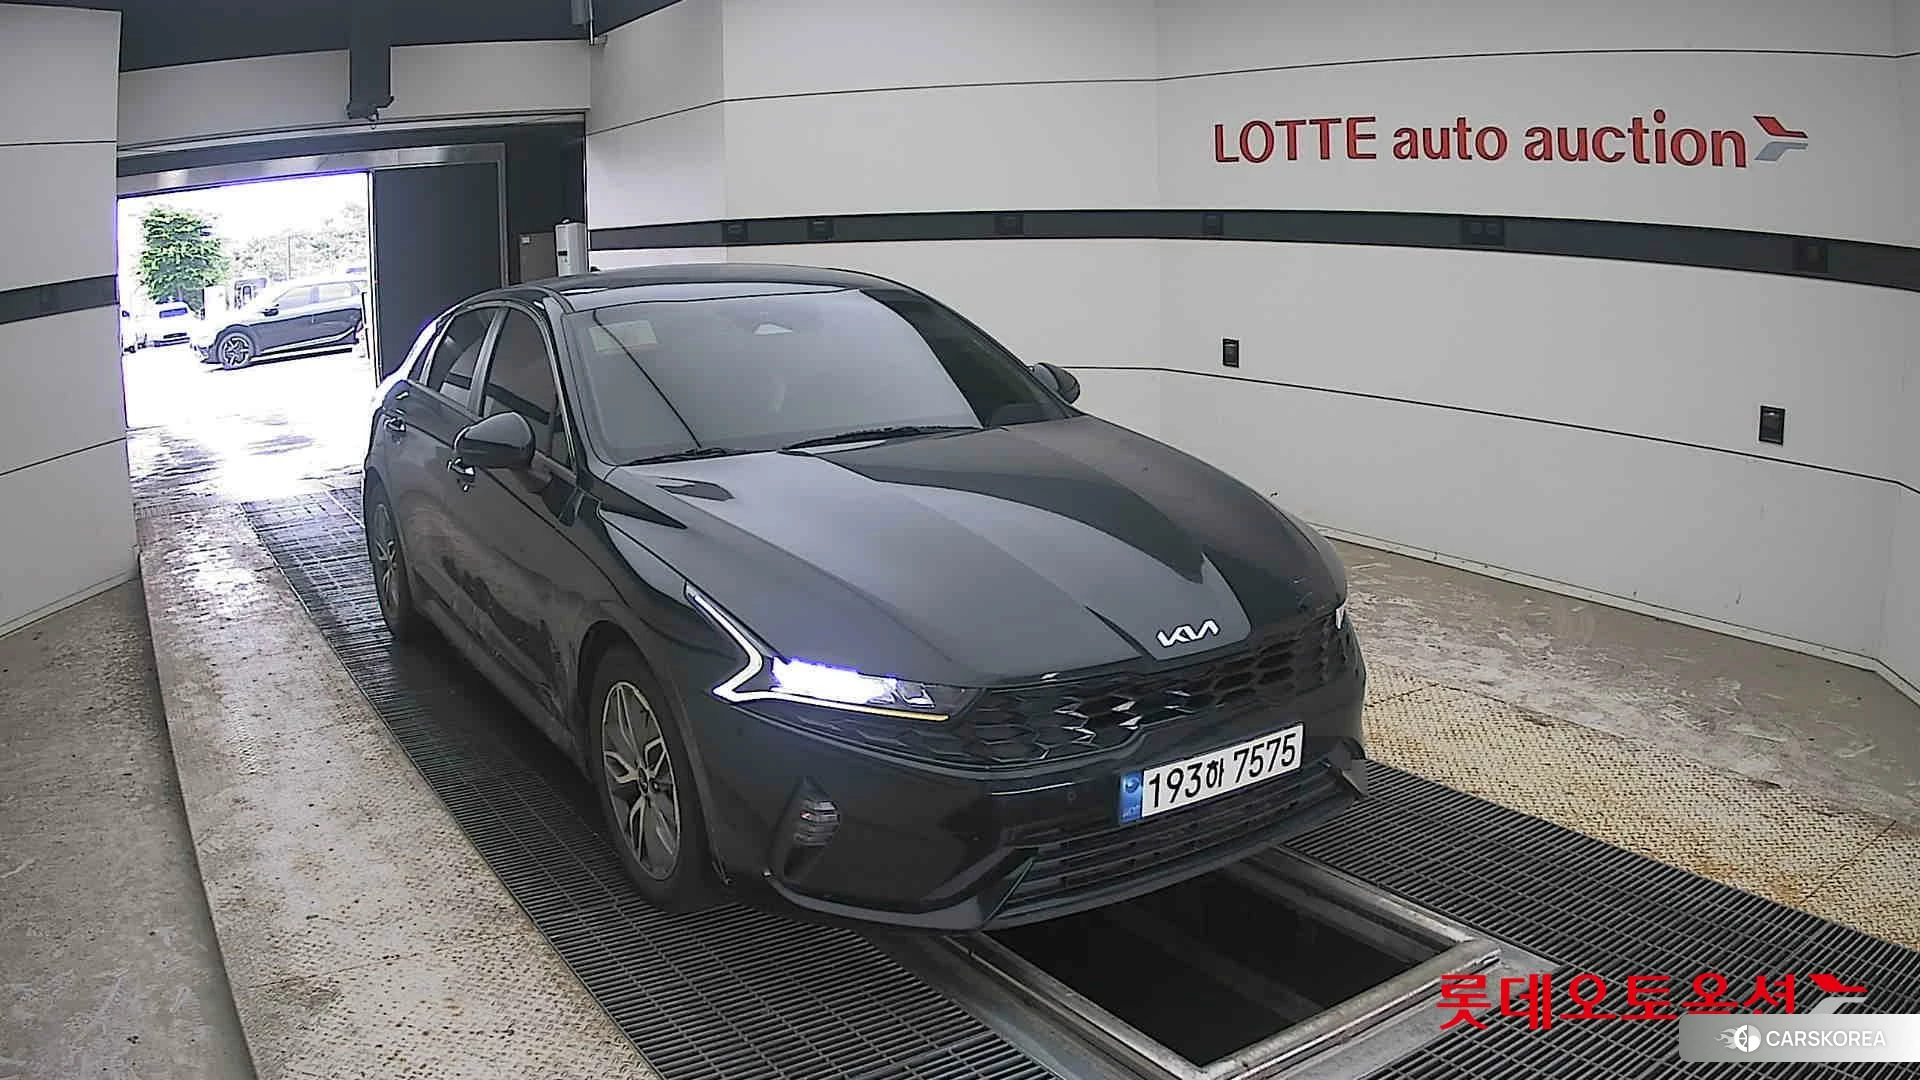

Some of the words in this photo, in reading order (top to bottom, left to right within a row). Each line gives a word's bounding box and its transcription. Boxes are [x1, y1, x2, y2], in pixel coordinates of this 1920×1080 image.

[1214, 116, 1377, 163] LOTTE
[1393, 116, 1508, 160] auto
[1524, 109, 1748, 168] auction
[1148, 758, 1225, 808] 193하
[1233, 733, 1296, 783] 7575
